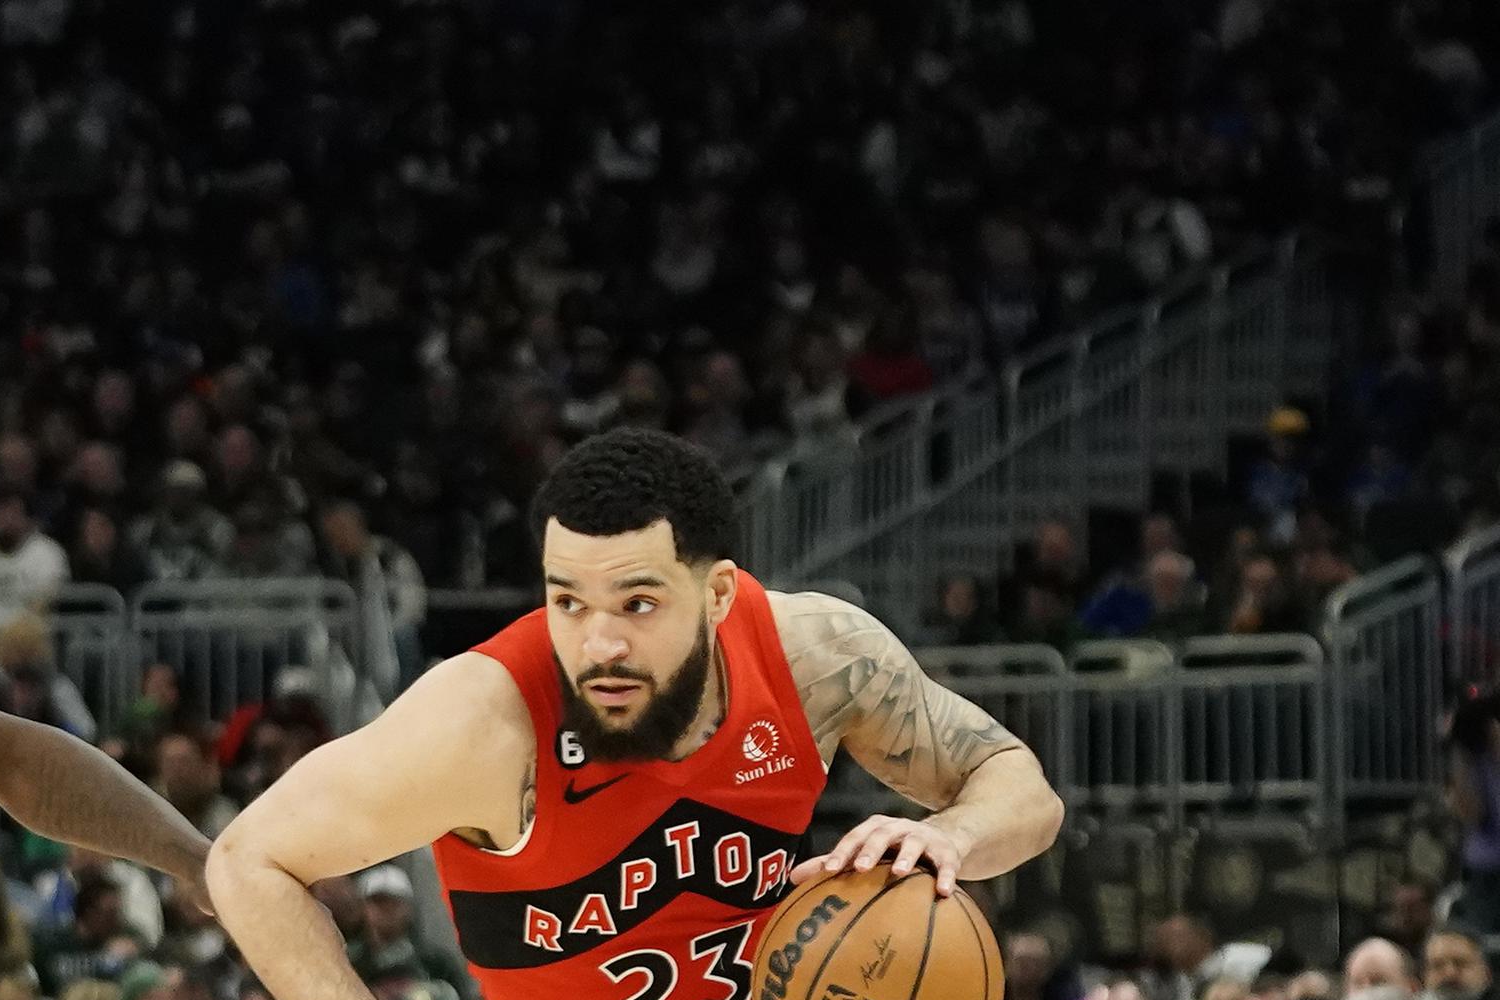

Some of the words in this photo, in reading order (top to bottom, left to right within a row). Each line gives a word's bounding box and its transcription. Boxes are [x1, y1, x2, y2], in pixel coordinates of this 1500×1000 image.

[561, 731, 585, 764] 6
[734, 769, 766, 785] Sun
[766, 754, 796, 774] Life
